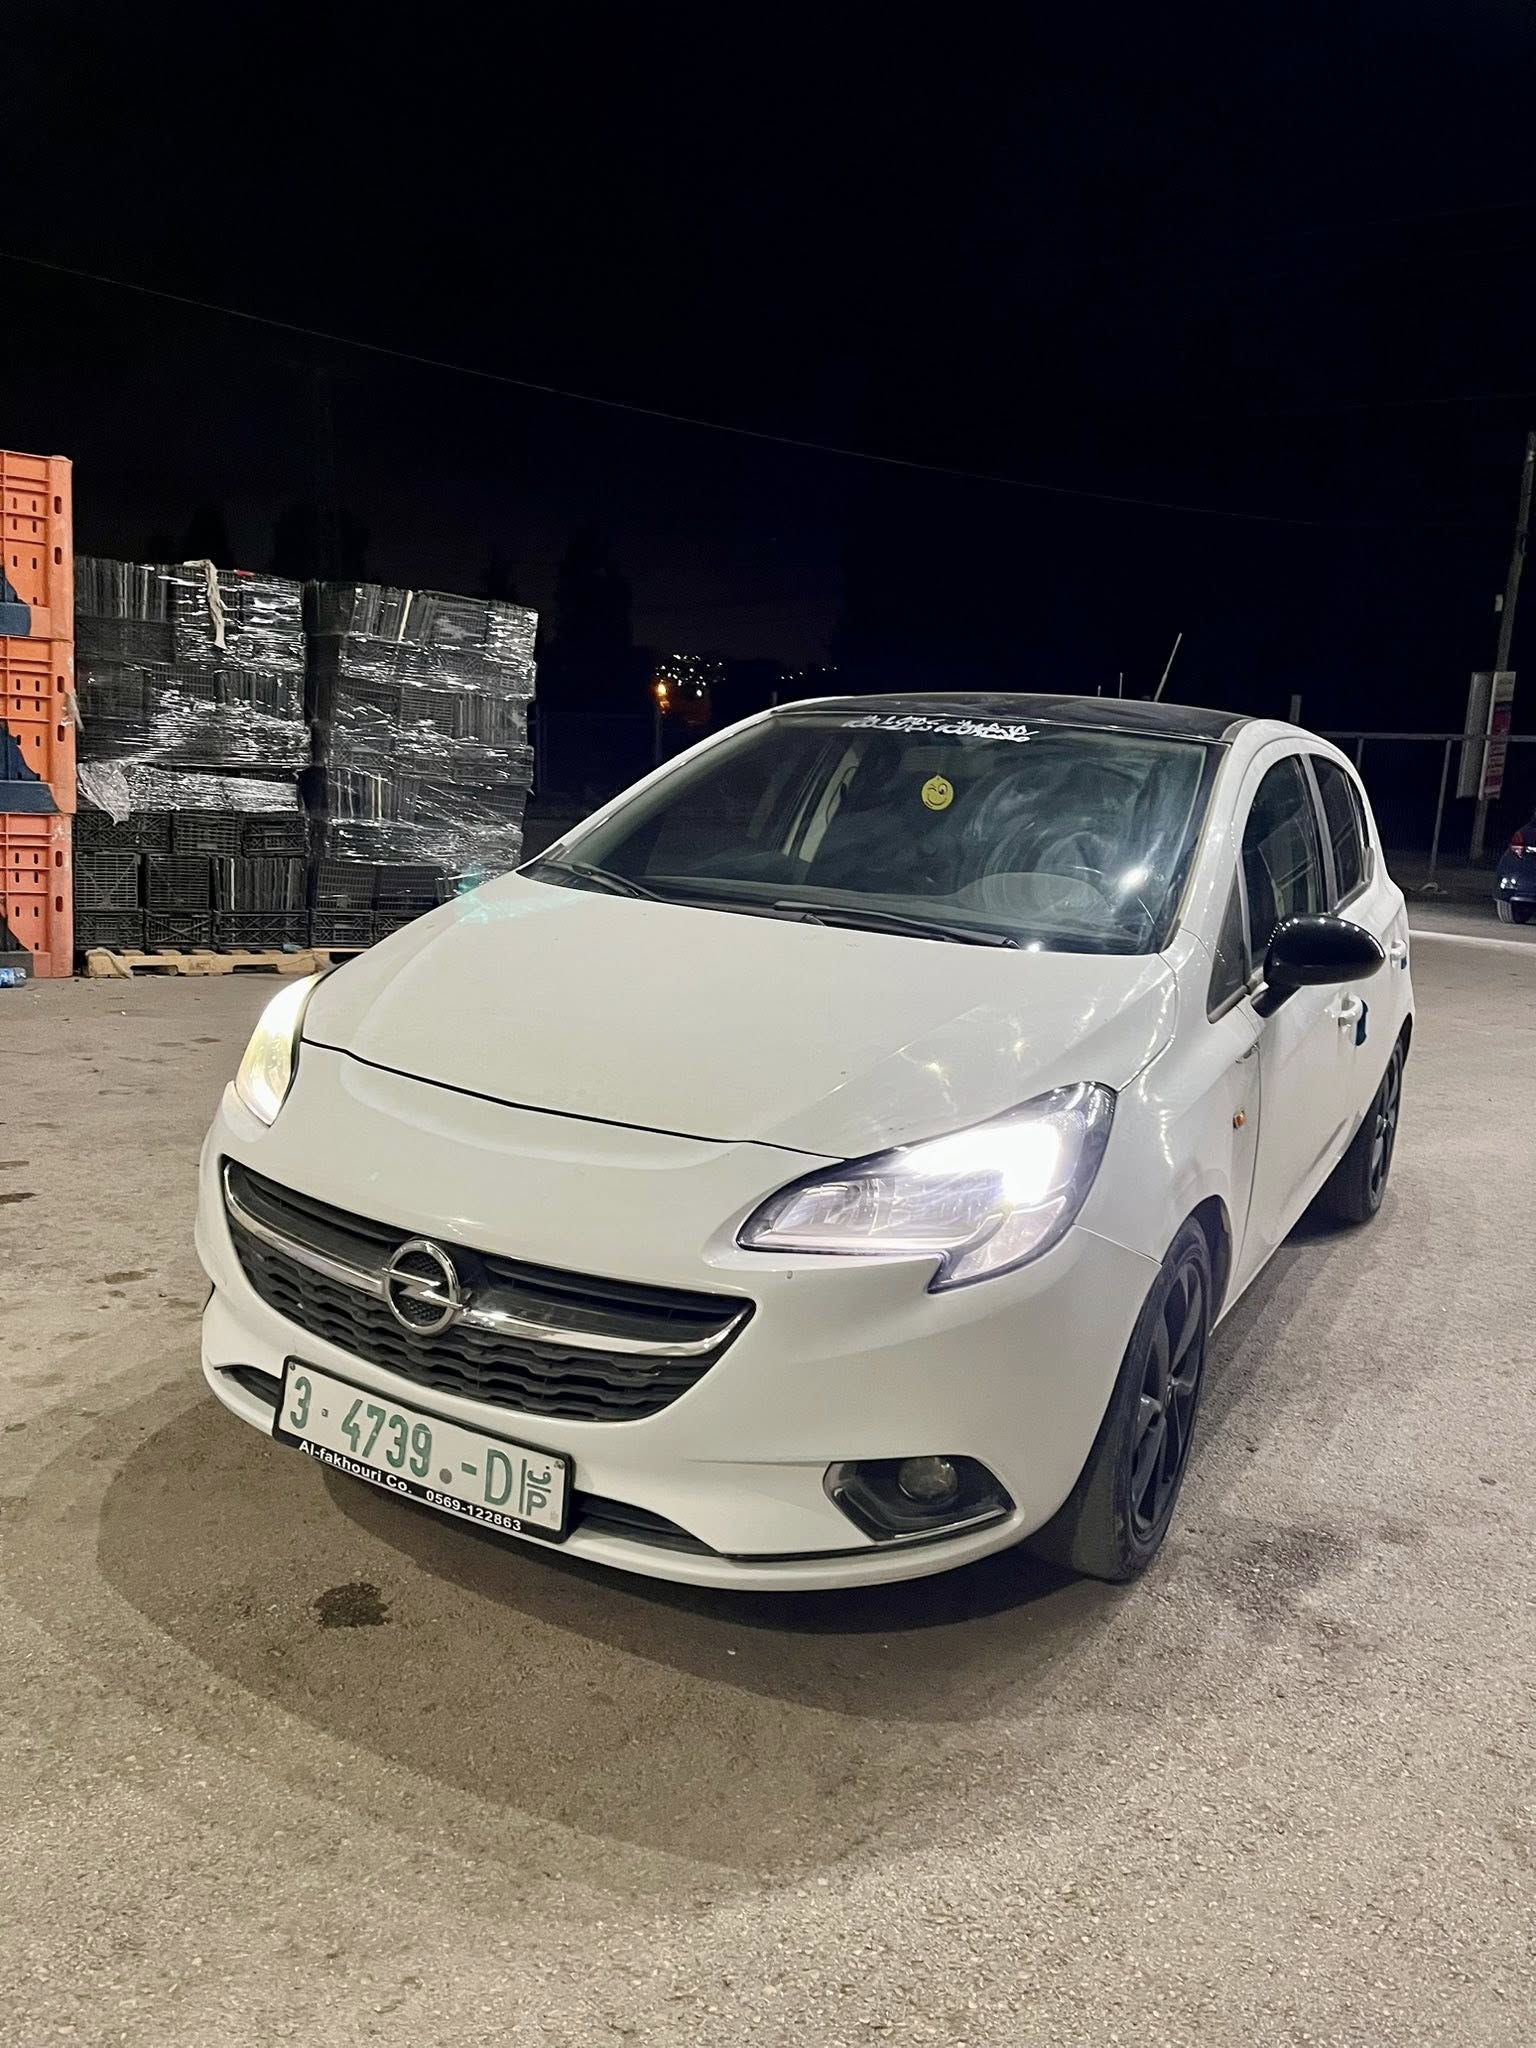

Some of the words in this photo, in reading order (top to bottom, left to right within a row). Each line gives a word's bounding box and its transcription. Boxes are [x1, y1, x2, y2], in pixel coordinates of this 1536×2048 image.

[341, 1398, 433, 1478] 4739
[299, 1440, 382, 1482] Al-fakhouri
[386, 1474, 412, 1494] Co.
[426, 1489, 521, 1531] 0569-122863
[526, 1489, 547, 1516] P
